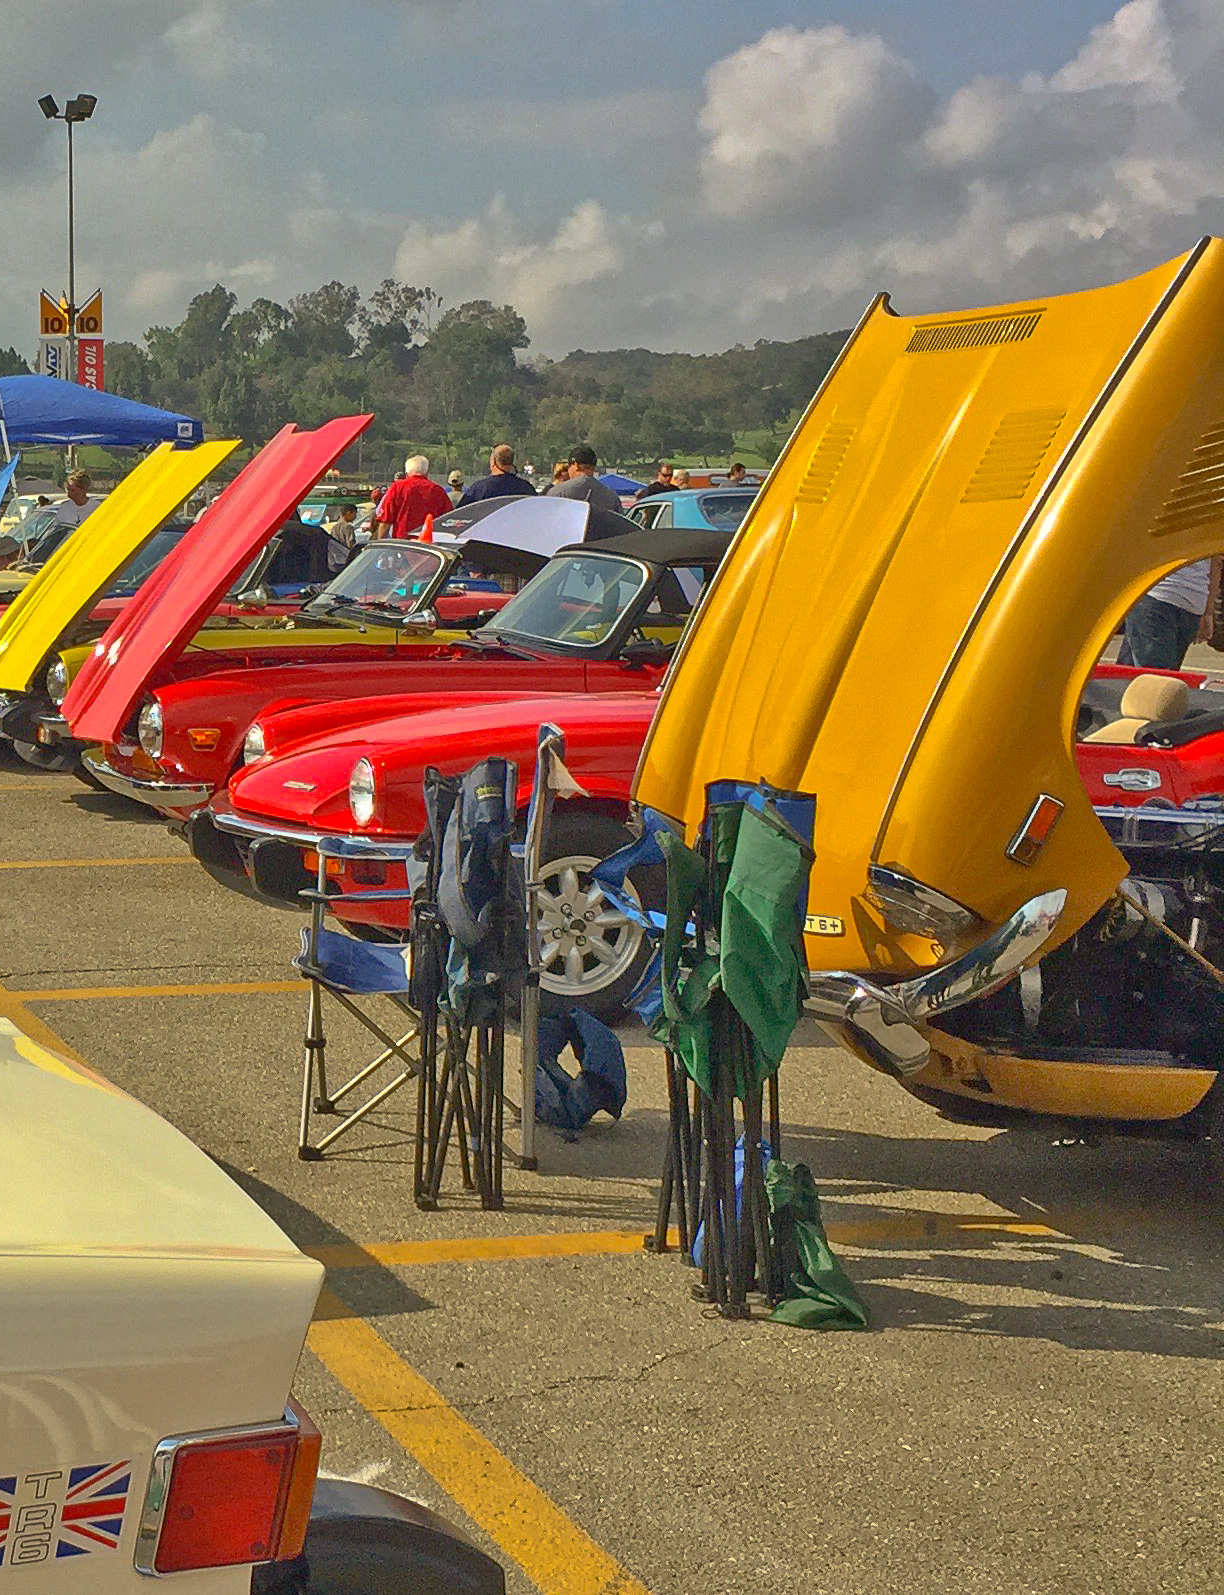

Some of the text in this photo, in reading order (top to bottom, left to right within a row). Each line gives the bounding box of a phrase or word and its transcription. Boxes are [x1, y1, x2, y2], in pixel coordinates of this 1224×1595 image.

[44, 317, 63, 333] 10
[80, 316, 99, 332] 10
[85, 345, 97, 390] CAS OIL
[807, 917, 839, 932] T6+
[9, 1470, 63, 1566] TR6
